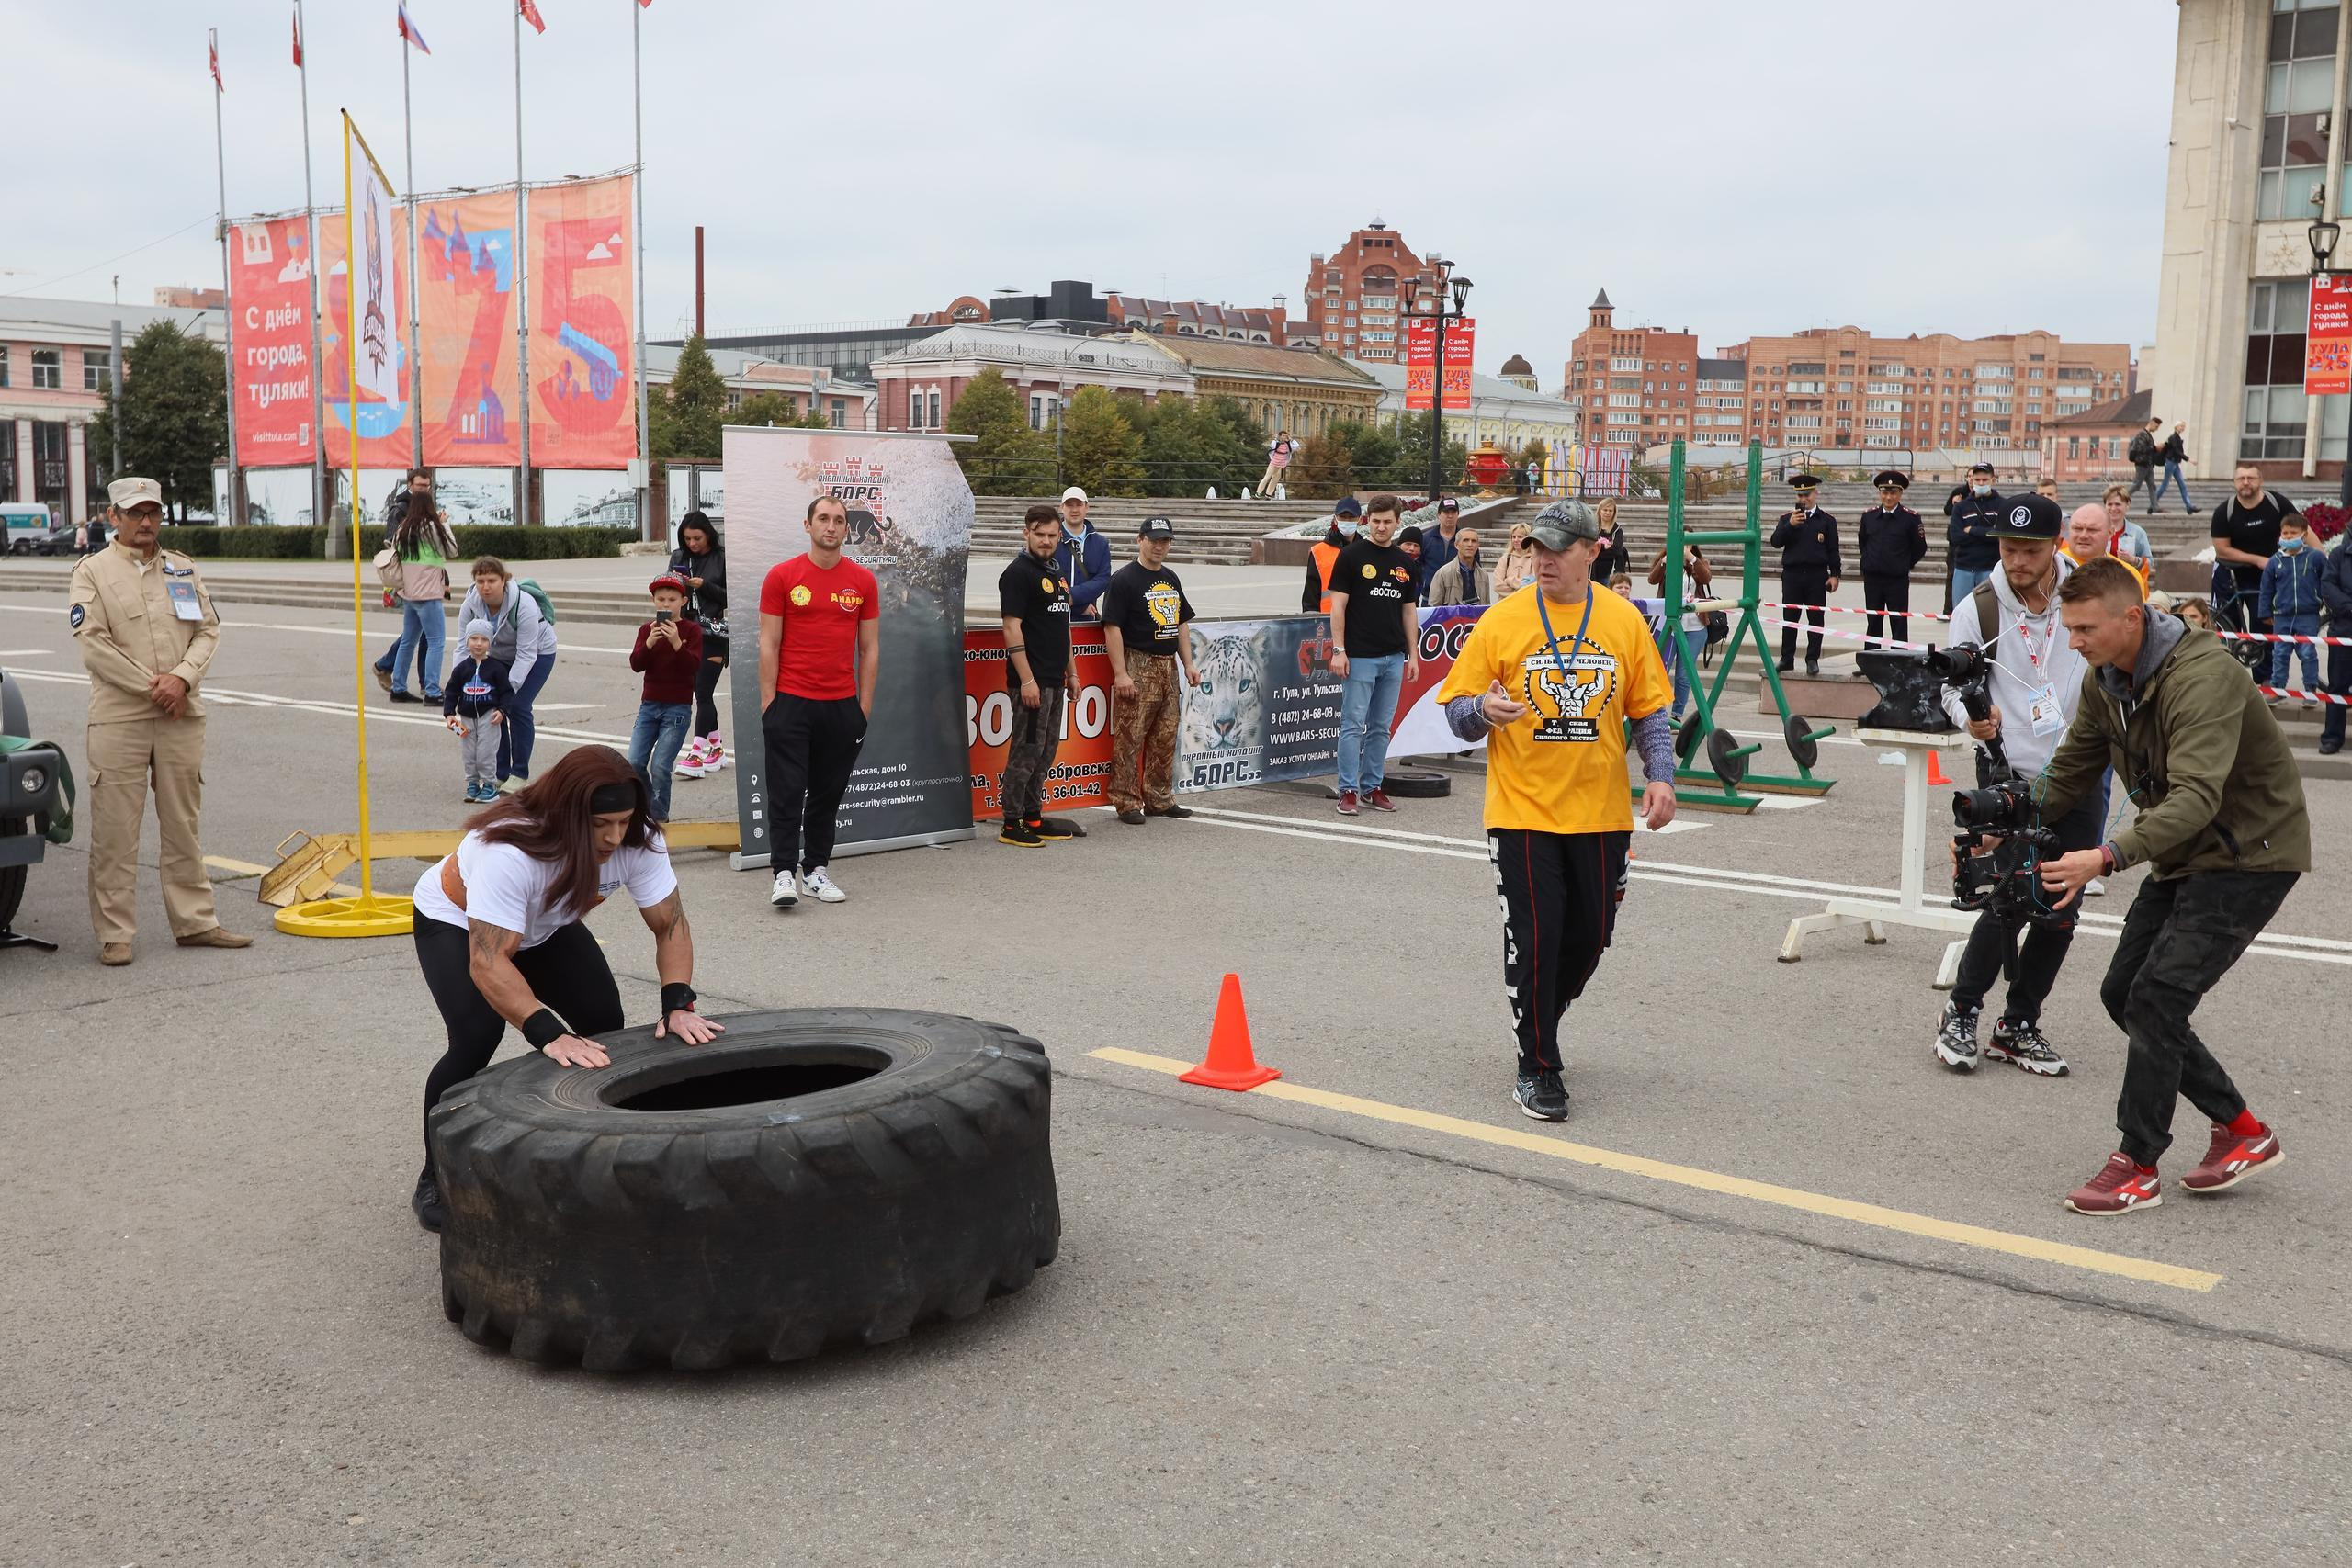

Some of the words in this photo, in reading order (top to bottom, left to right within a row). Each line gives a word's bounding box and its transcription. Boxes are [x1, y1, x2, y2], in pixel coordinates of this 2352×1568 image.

[2323, 301, 2346, 311] днём
[245, 306, 259, 329] С
[265, 302, 301, 332] днём
[2313, 312, 2349, 321] города,
[2313, 320, 2349, 331] туляки!
[247, 343, 307, 371] города,
[248, 375, 309, 409] туляки!
[252, 432, 297, 443] visittula.com
[1047, 602, 1070, 613] «ВОСТО
[1576, 658, 1611, 666] ЧЕЛОВЕК
[1273, 690, 1281, 699] г.
[1282, 687, 1300, 701] Тула,
[1301, 686, 1312, 700] ул.
[1271, 714, 1276, 724] 8
[1278, 709, 1300, 726] (4872)
[1301, 707, 1333, 721] 24-68-03
[1227, 746, 1264, 757] ХОЛДИНГ
[1269, 756, 1288, 766] ЗАКАЗ
[1288, 754, 1307, 764] УСЛУГИ
[1307, 750, 1330, 761] ОНЛАЙН:
[881, 765, 897, 774] дом
[899, 763, 907, 772] 10
[912, 775, 964, 787] (круглосуточно)
[1053, 782, 1101, 799] 36-01-42
